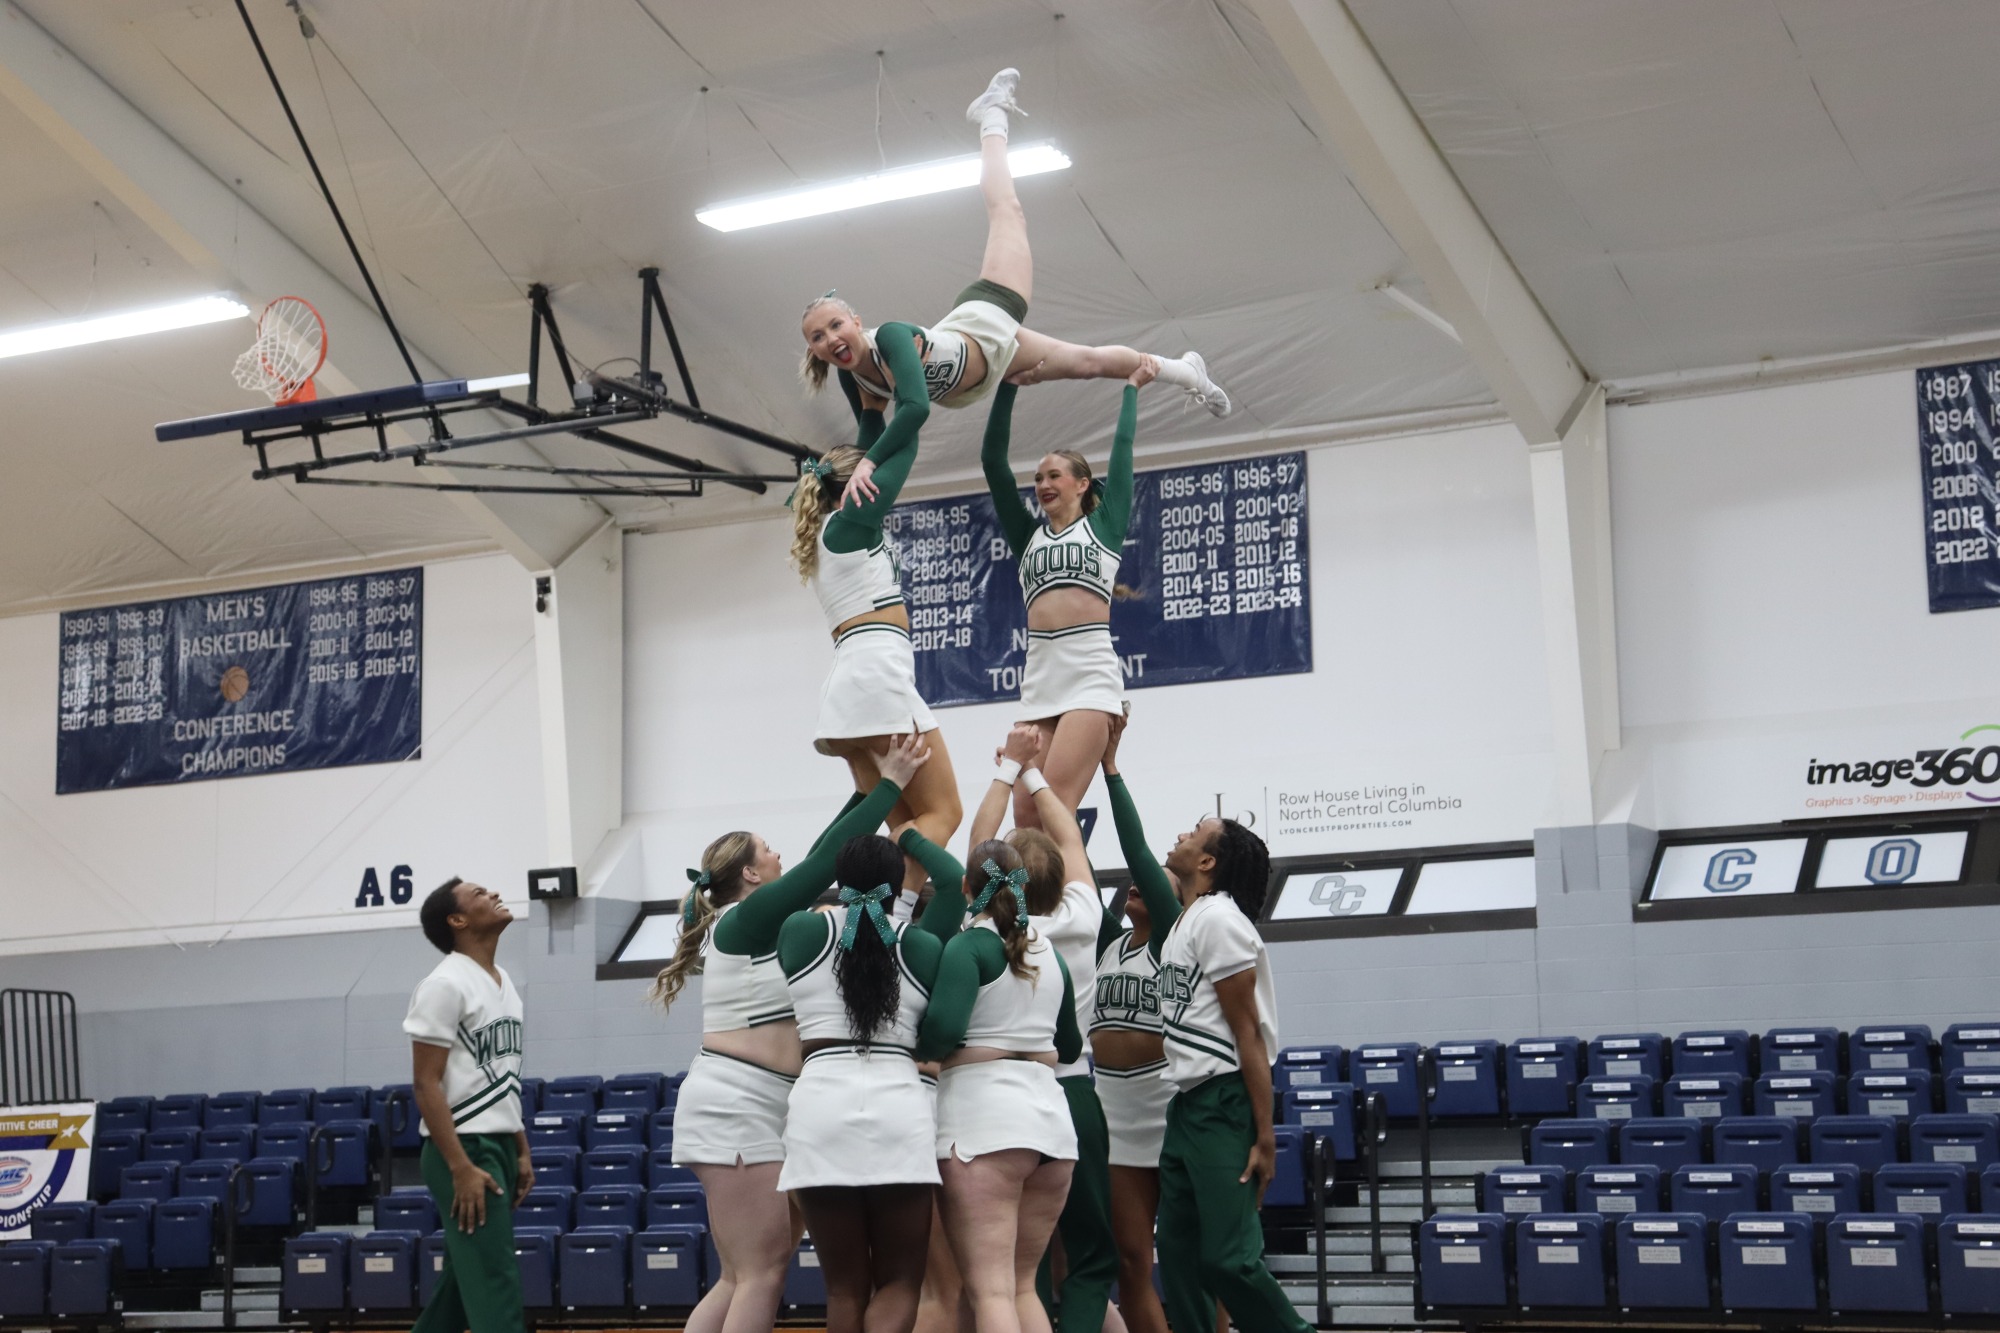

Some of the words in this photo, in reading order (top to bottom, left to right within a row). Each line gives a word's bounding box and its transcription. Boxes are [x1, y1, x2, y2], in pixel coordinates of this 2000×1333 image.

[1926, 374, 1972, 401] 1987
[1928, 406, 1977, 434] 1994
[1930, 440, 1978, 467] 2000
[1160, 473, 1222, 499] 1995-96
[1234, 463, 1297, 490] 1996-97
[1932, 473, 1979, 500] 2006
[912, 505, 970, 530] 1994-95
[1161, 502, 1224, 528] 2000-01
[1235, 493, 1299, 519] 2001-02
[1932, 505, 1985, 533] 2012
[912, 534, 970, 558] 1999-00
[1162, 525, 1225, 551] 2004-05
[1234, 517, 1298, 544] 2005-06
[1162, 549, 1218, 575] 2010-11
[1235, 541, 1297, 567] 2011-12
[1935, 537, 1989, 565] 2022
[912, 557, 970, 581] 2003-04
[1163, 571, 1229, 598] 2014-15
[1235, 563, 1302, 590] 2015-16
[309, 584, 358, 607] 1994-95
[366, 577, 415, 600] 1996-97
[1163, 594, 1231, 621] 2022-23
[1236, 586, 1303, 614] 2023-24
[206, 597, 266, 623] MEN'S
[310, 609, 358, 632] 2000-01
[366, 603, 415, 626] 2003-04
[912, 604, 972, 629] 2013-14
[64, 615, 109, 637] 1990-91
[365, 629, 414, 651] 2011-12
[911, 627, 971, 652] 2017-18
[178, 627, 292, 659] BASKETBALL
[309, 662, 358, 683] 2015-16
[364, 655, 416, 678] 2016-17
[173, 709, 295, 741] CONFERENCE
[181, 744, 287, 774] CHAMPIONS
[1279, 792, 1310, 806] Row
[1314, 789, 1360, 803] House
[1364, 785, 1408, 801] Living
[1411, 782, 1425, 796] in
[1805, 795, 1854, 808] Graphics
[1863, 792, 1907, 806] Signage
[1914, 789, 1963, 802] Displays
[1279, 805, 1322, 822] North
[1326, 802, 1383, 818] Central
[1387, 796, 1462, 814] Columbia
[1279, 819, 1413, 836] LYONCRESTPROPERTIES.COM
[1703, 848, 1758, 893] C
[355, 864, 413, 908] A6
[28, 1119, 58, 1130] CHEER
